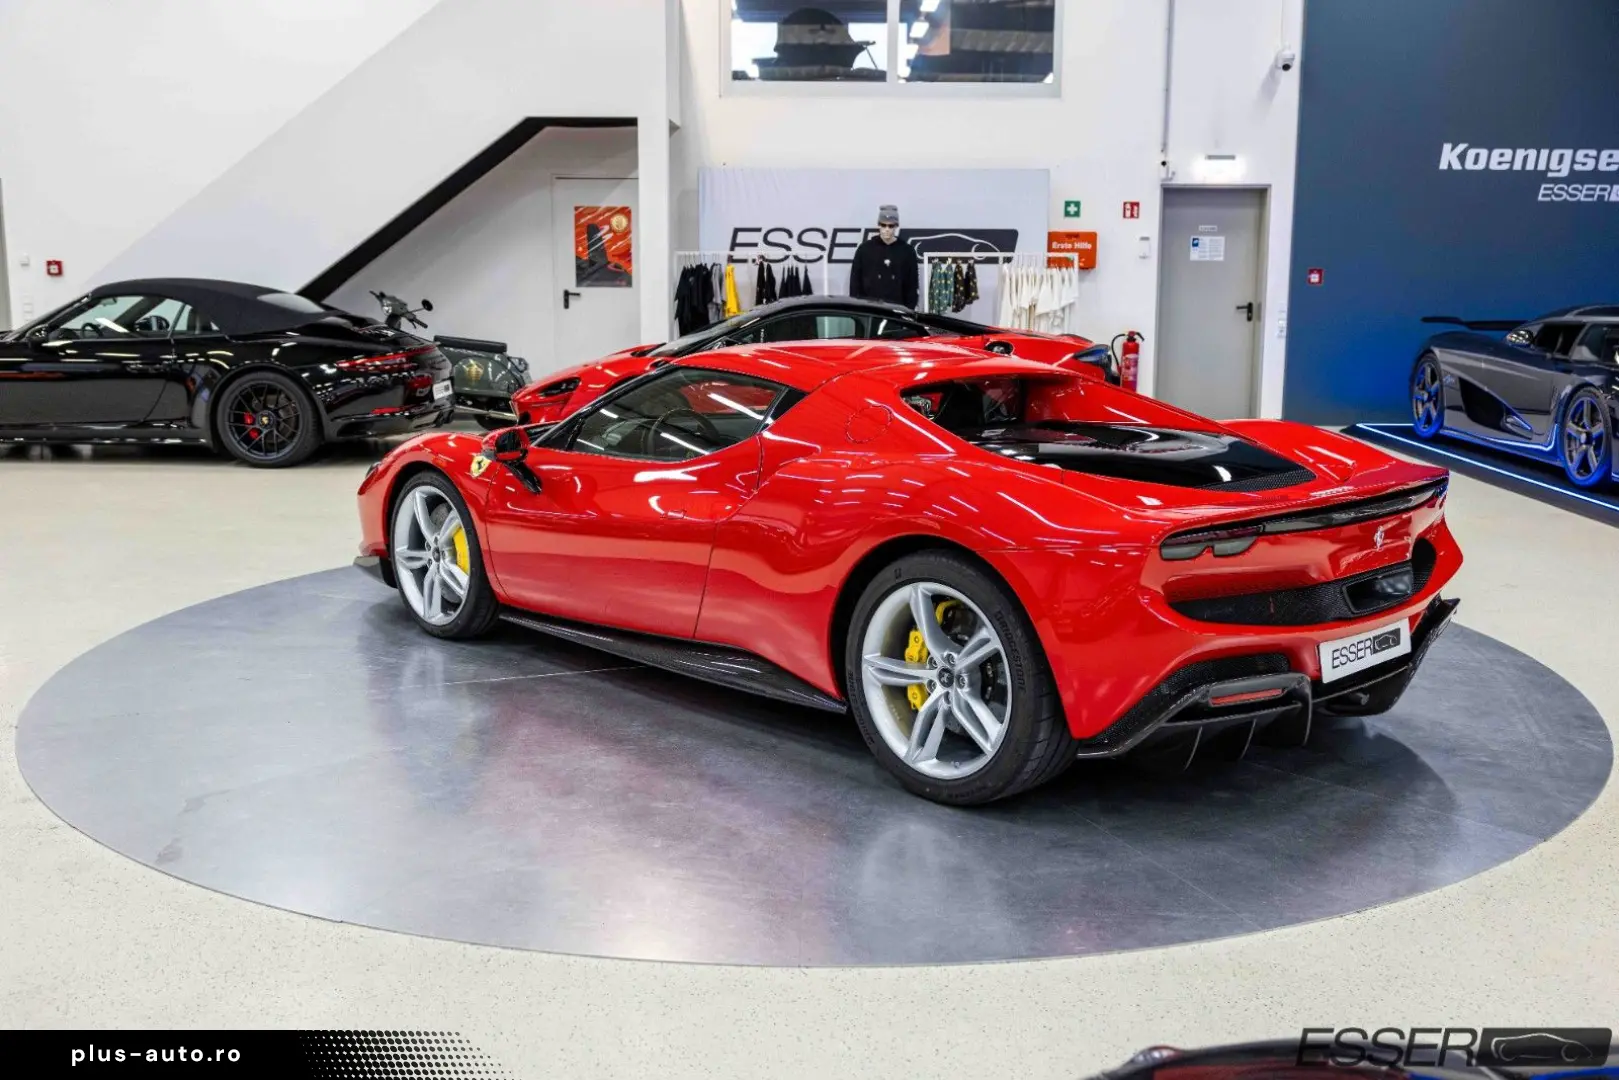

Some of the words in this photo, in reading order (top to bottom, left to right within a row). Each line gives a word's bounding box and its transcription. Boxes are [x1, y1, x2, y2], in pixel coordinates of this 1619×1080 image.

[1537, 184, 1611, 201] ESSER
[1052, 241, 1072, 249] Erste
[1074, 241, 1092, 250] Hilfe
[1331, 637, 1373, 669] ESSER
